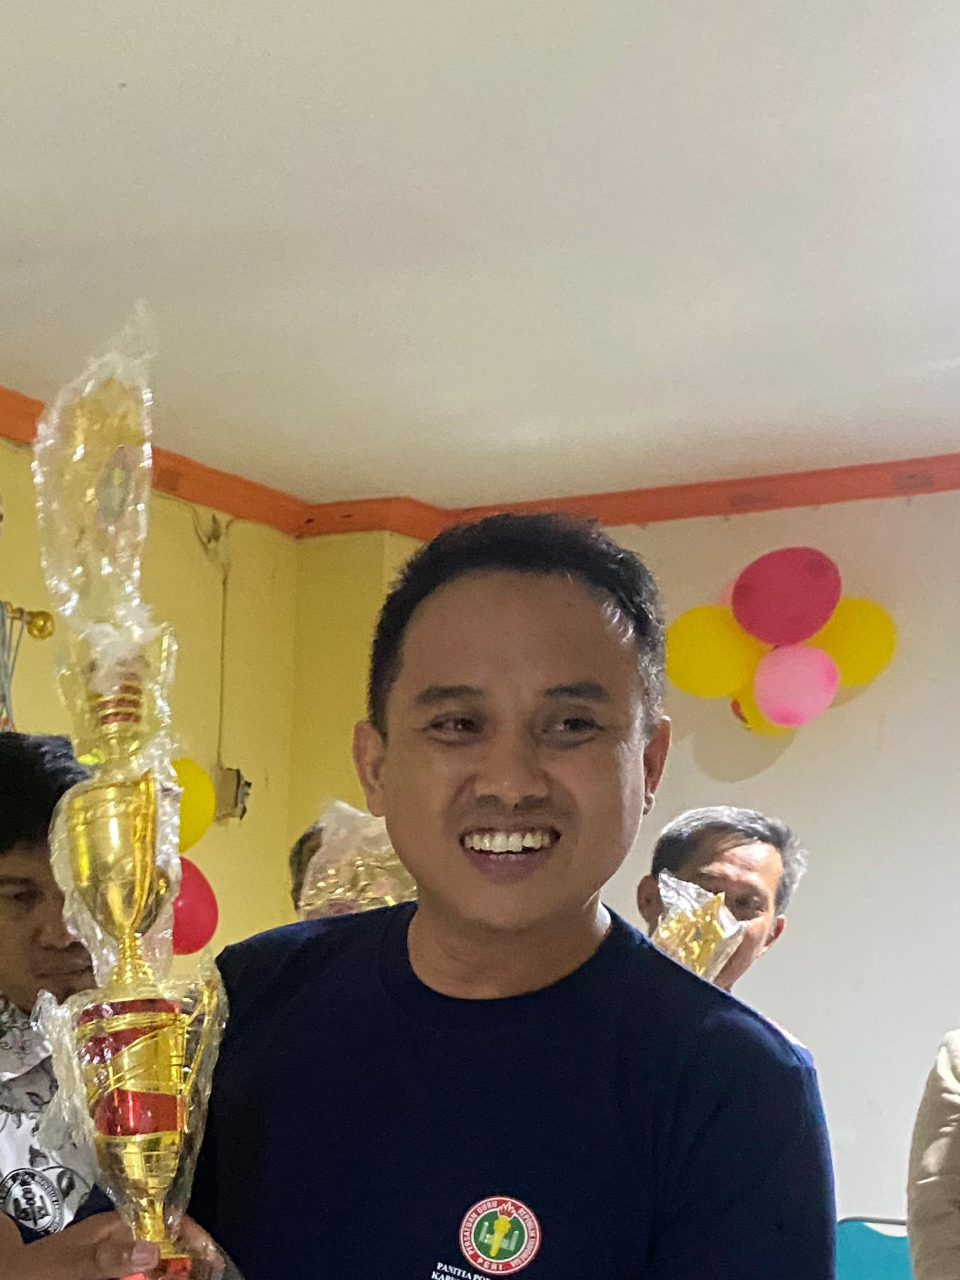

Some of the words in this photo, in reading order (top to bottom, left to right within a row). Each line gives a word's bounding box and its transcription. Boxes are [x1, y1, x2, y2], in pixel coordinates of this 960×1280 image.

[463, 1212, 478, 1255] PERSATUAN
[436, 1262, 472, 1280] PANITIA
[476, 1257, 503, 1271] PGRI
